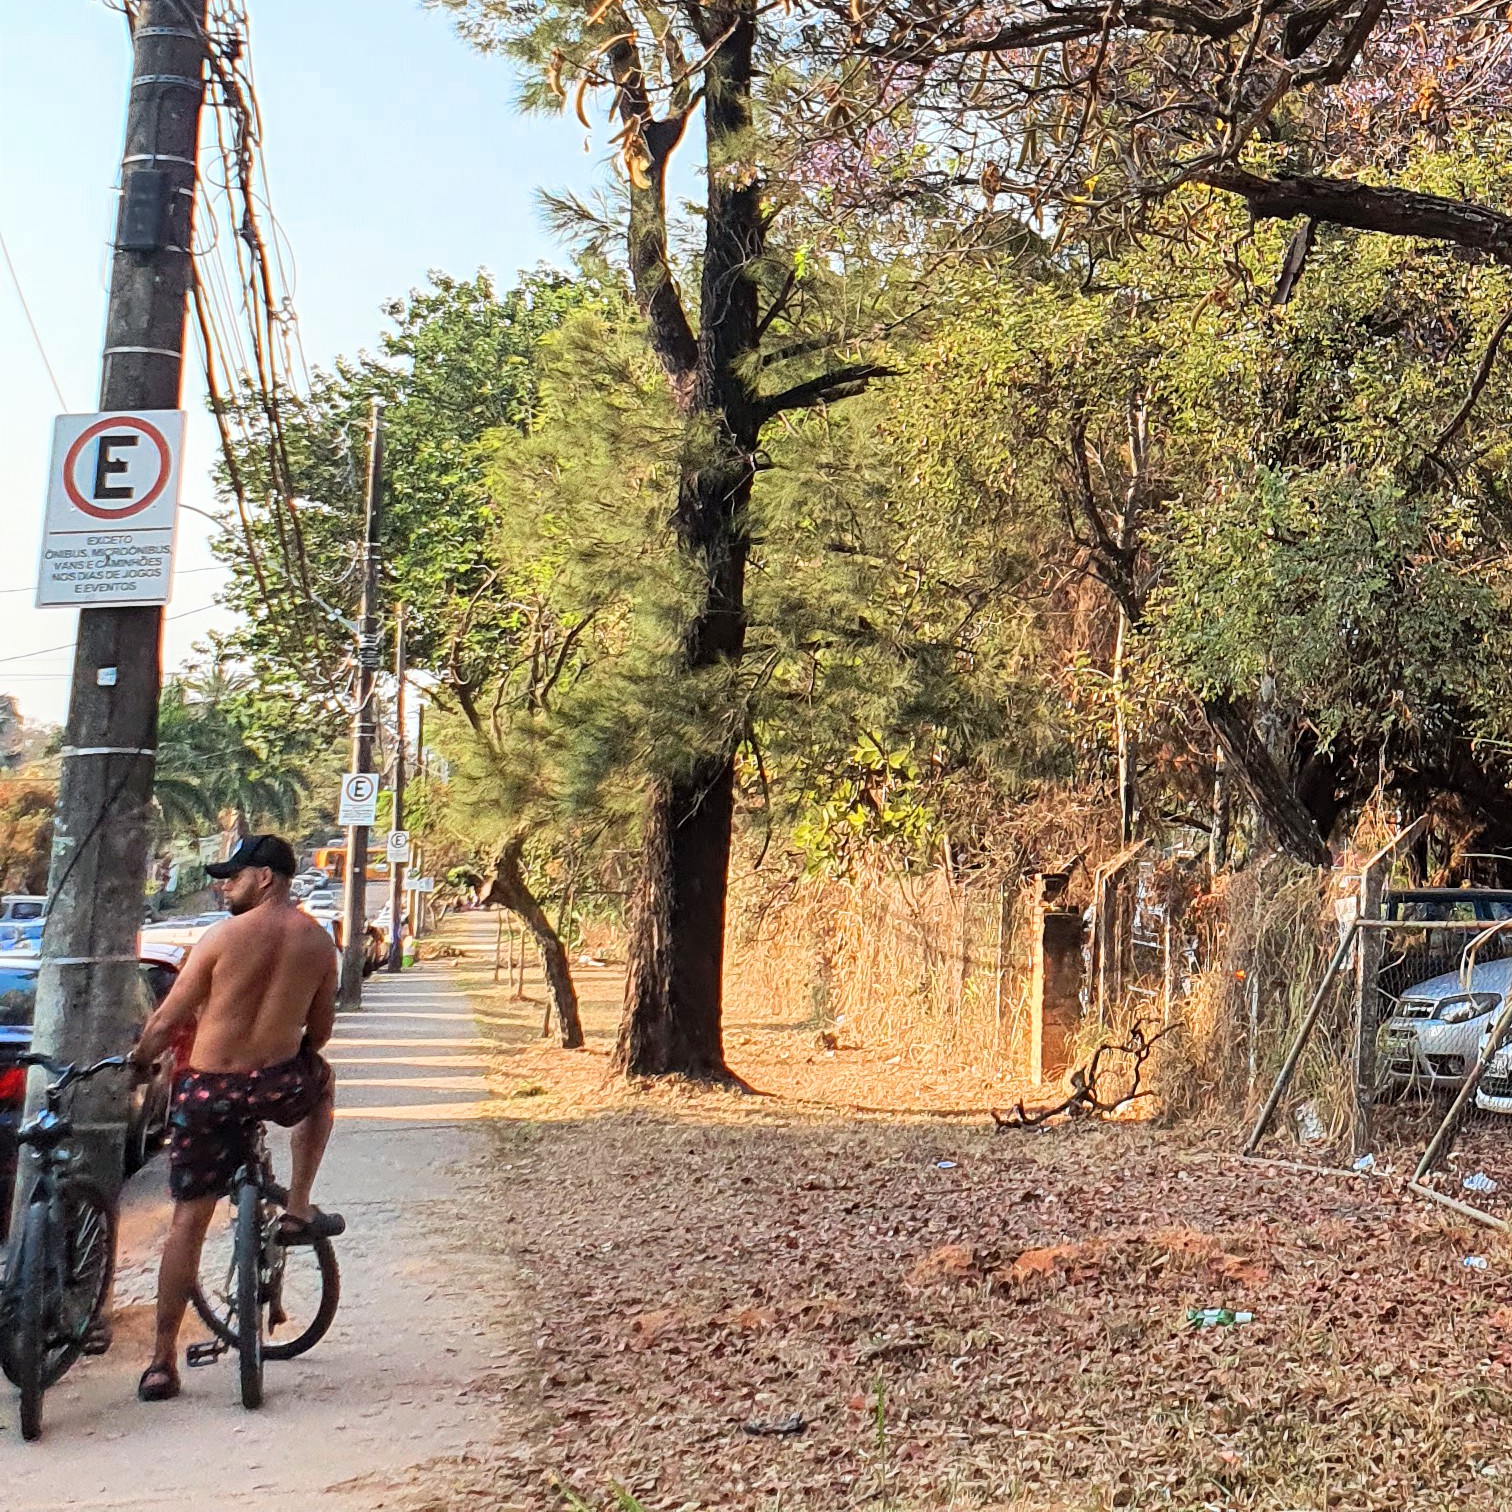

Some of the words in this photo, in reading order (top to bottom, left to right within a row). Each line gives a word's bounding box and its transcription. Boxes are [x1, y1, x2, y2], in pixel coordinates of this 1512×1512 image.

[93, 435, 140, 500] E
[87, 535, 133, 545] EXCETO
[54, 561, 84, 570] VANS
[52, 572, 75, 581] NOS
[78, 571, 103, 580] DIAS
[105, 570, 120, 579] DE
[122, 568, 162, 579] JOGOS
[75, 584, 82, 593] E
[84, 582, 137, 593] EVENTOS
[354, 780, 366, 797] E
[395, 835, 402, 845] E
